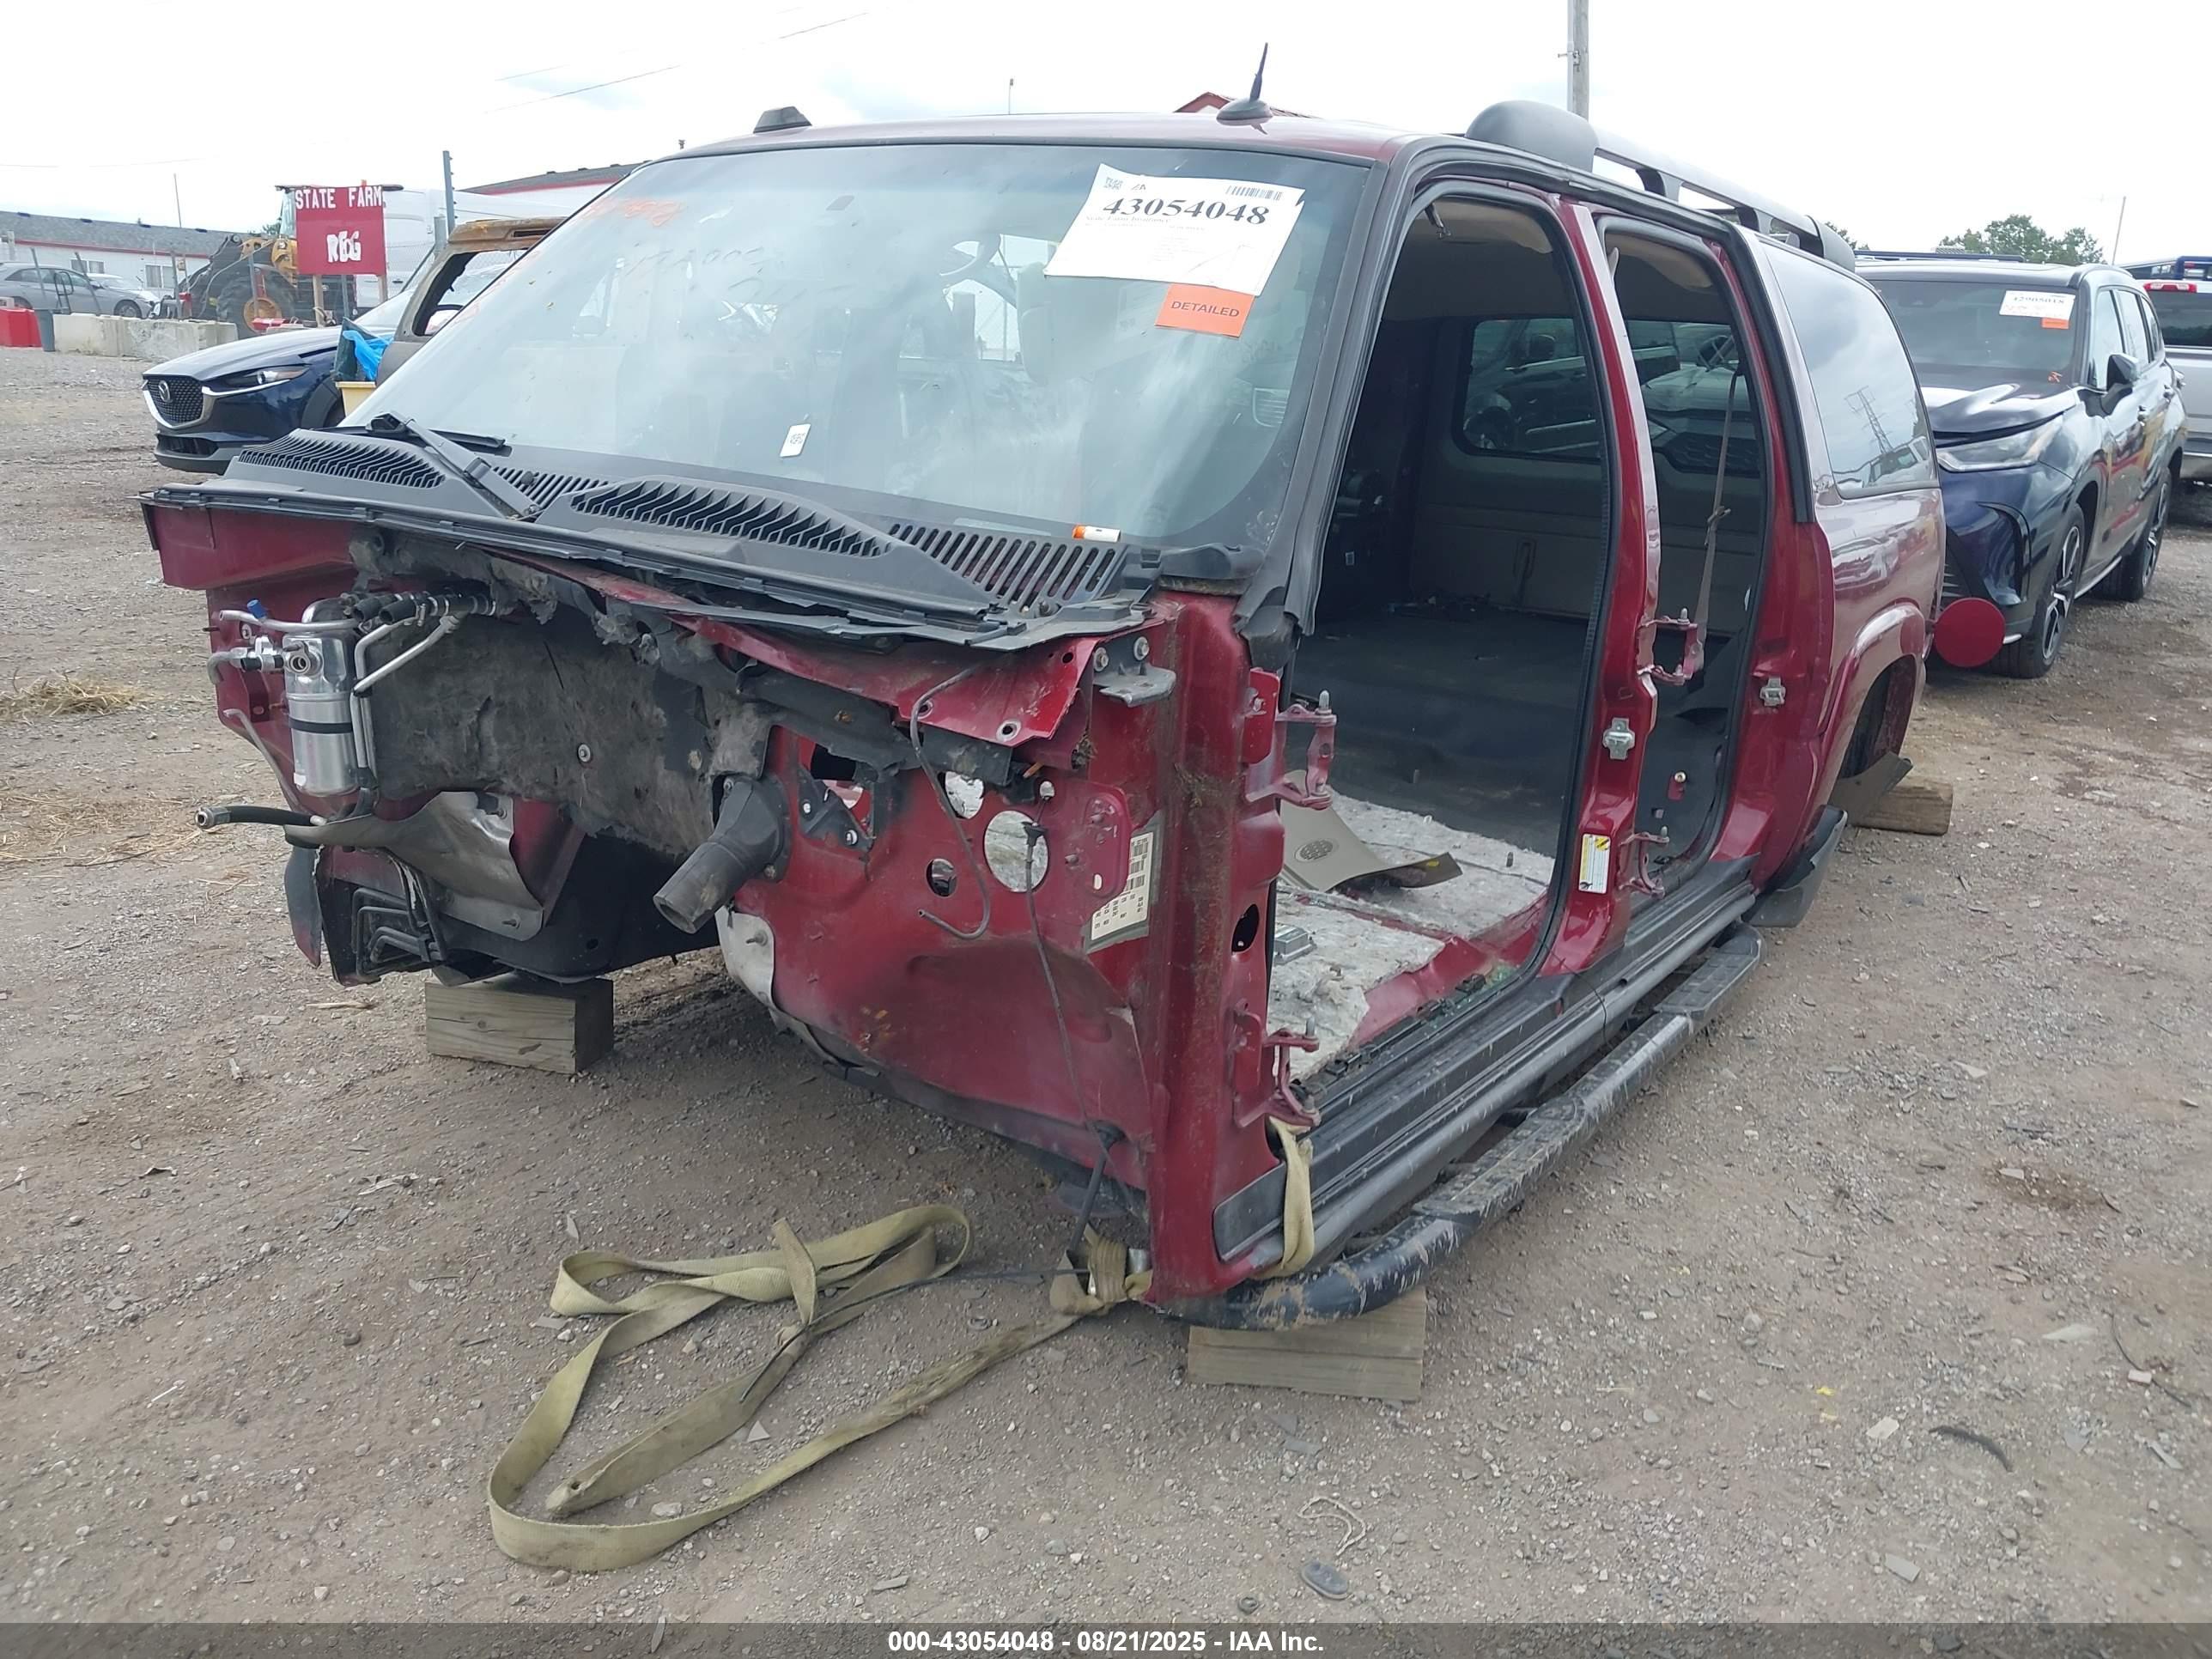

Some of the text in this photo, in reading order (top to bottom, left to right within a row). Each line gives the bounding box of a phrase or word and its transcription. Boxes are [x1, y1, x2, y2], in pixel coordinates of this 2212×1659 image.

[295, 186, 383, 210] STATE FARM
[1103, 198, 1270, 225] 43054048
[1170, 301, 1240, 318] DETAILED
